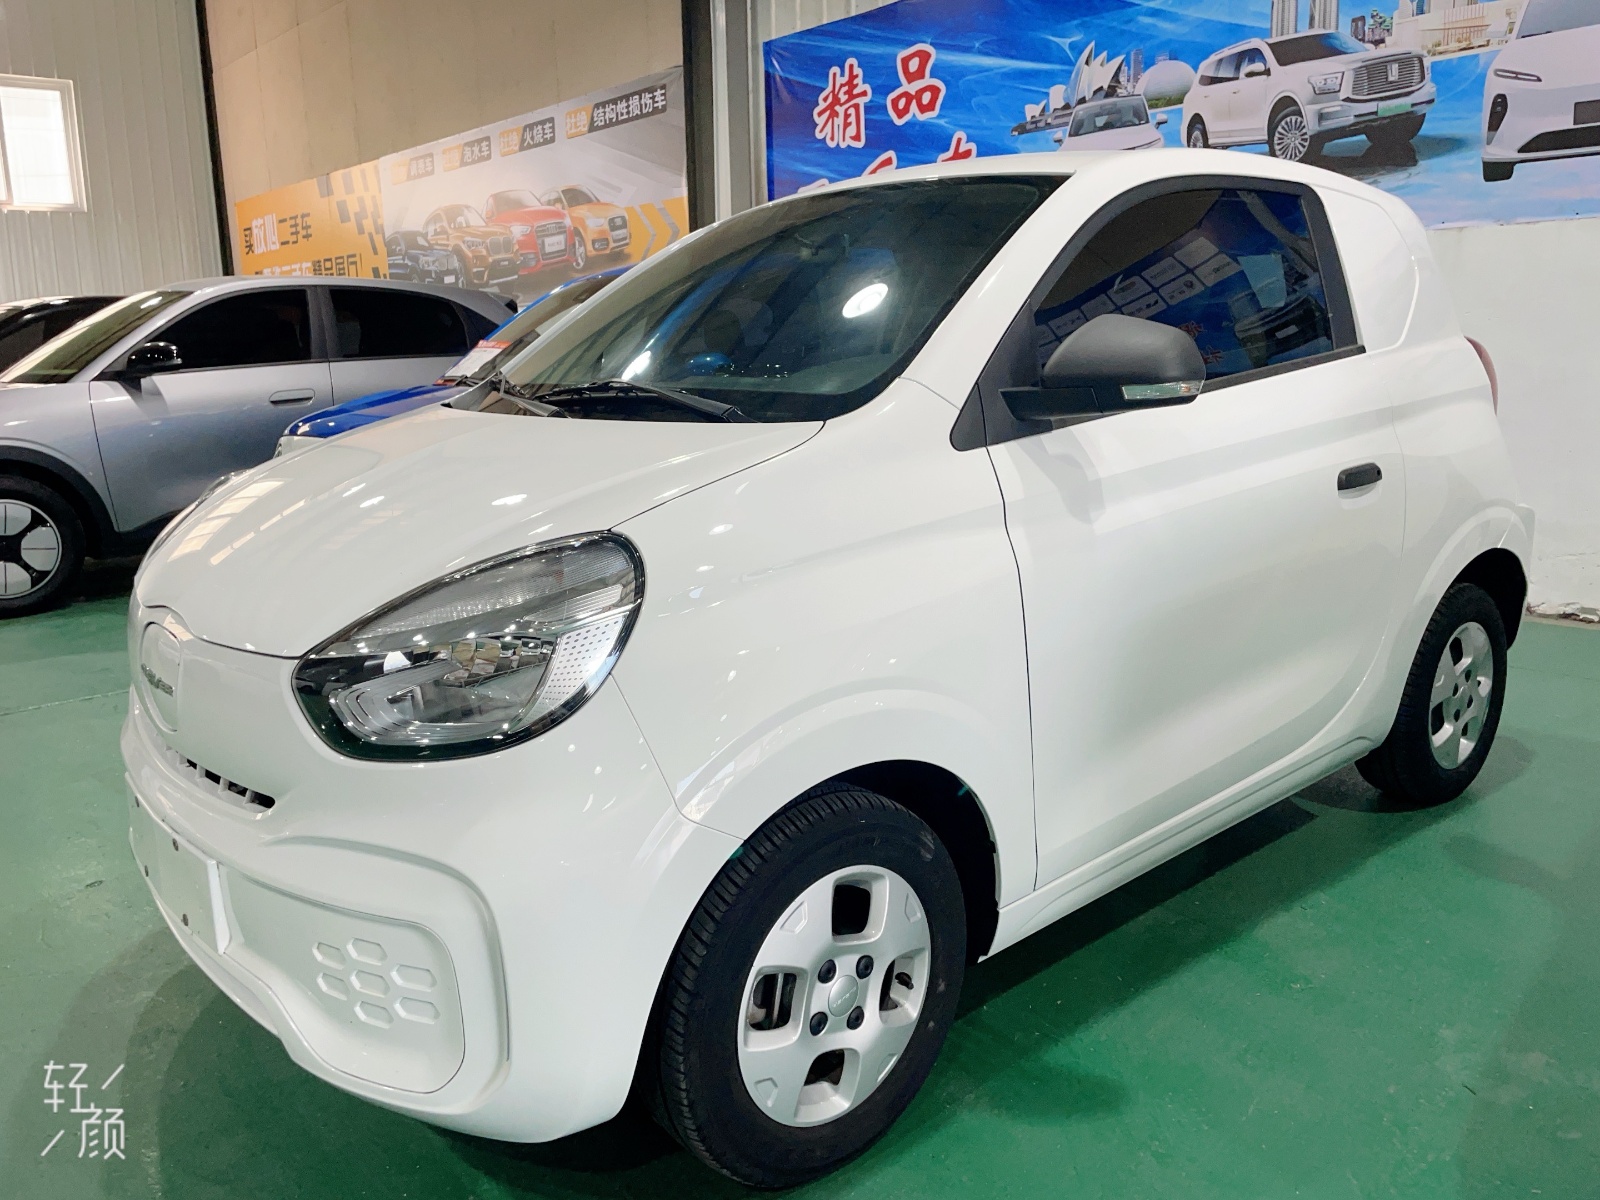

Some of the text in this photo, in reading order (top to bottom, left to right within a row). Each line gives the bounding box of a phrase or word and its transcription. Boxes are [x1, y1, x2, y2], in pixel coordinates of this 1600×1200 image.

[814, 44, 946, 148] 精品
[524, 122, 554, 148] 火烧车
[243, 212, 313, 256] 买放心二手车
